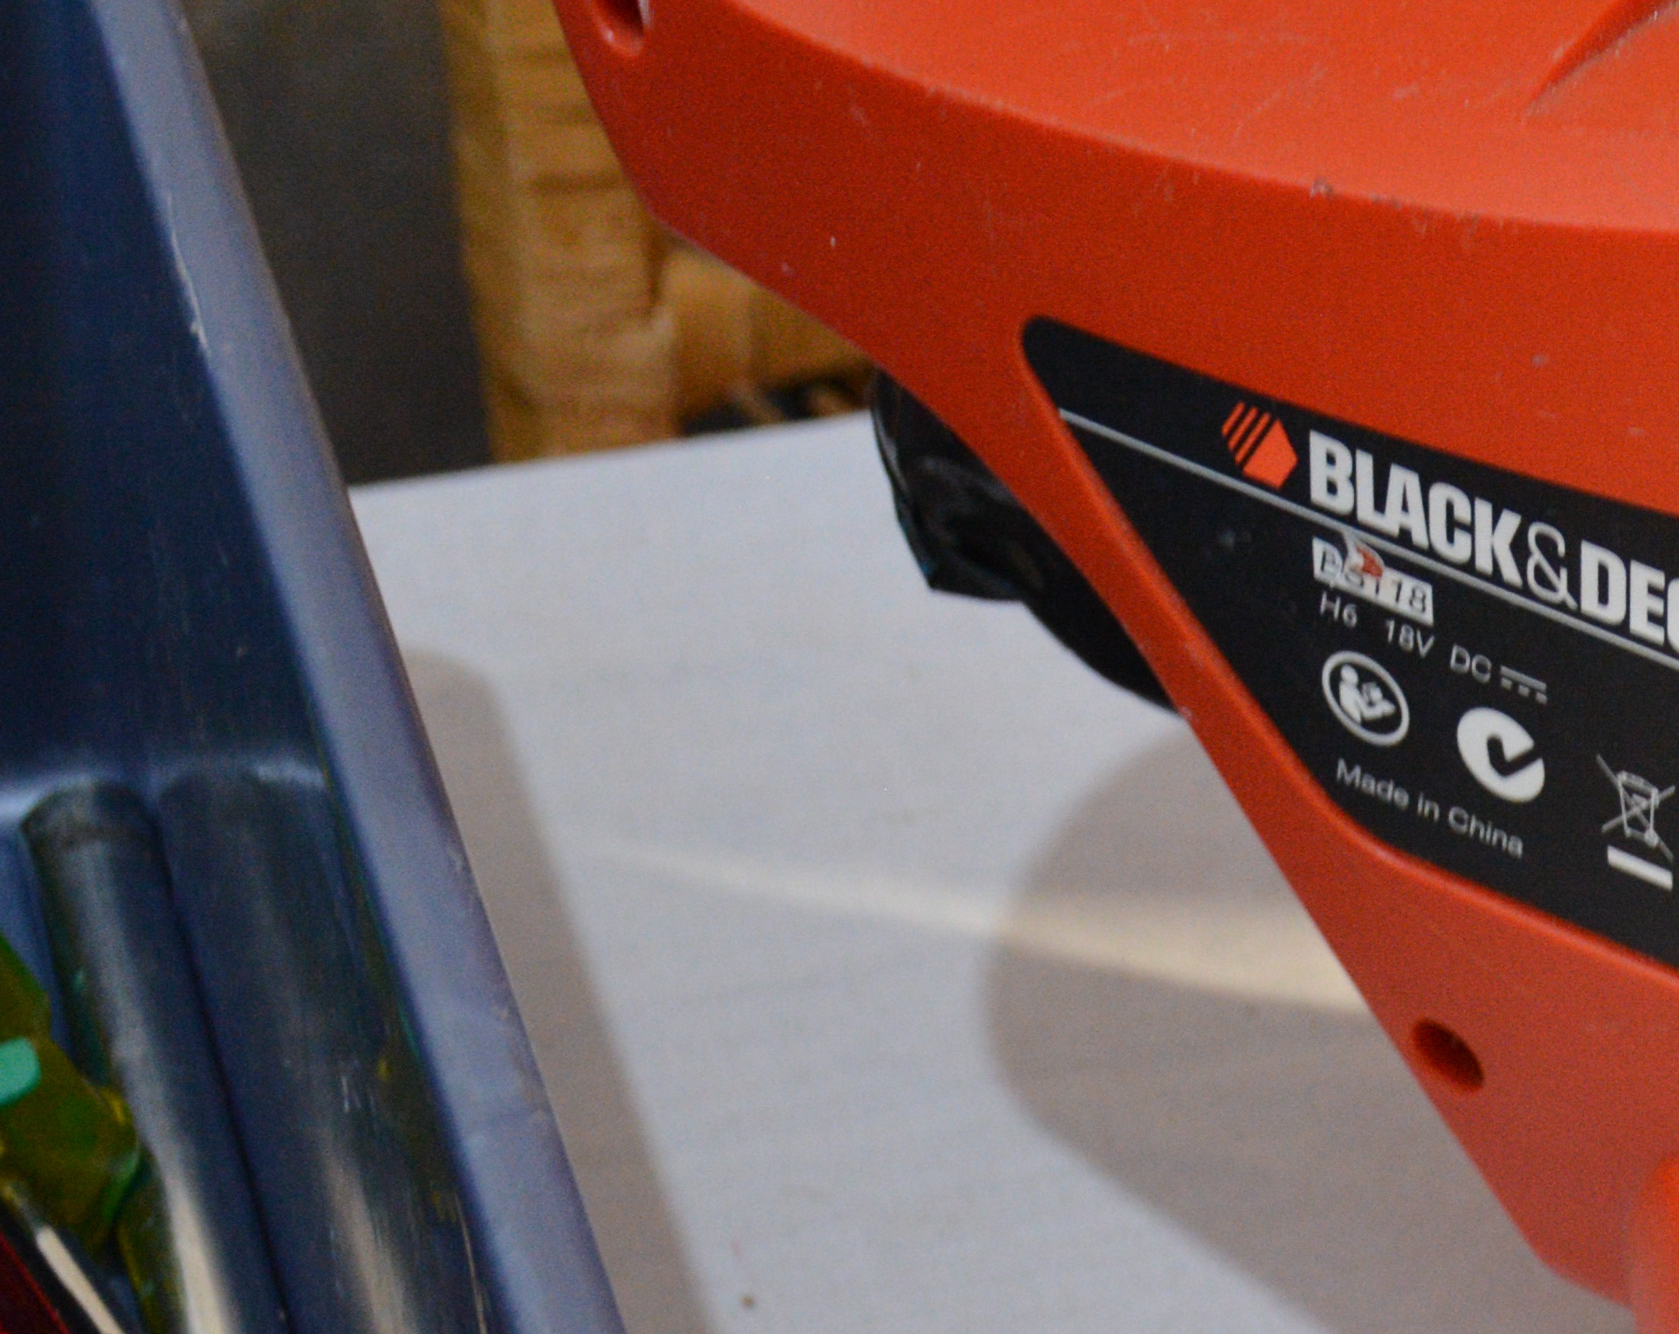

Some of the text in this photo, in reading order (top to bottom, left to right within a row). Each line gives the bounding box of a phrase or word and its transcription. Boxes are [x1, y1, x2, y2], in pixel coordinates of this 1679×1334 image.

[1319, 590, 1492, 685] H6 18V DC
[1335, 758, 1525, 860] Made in China
